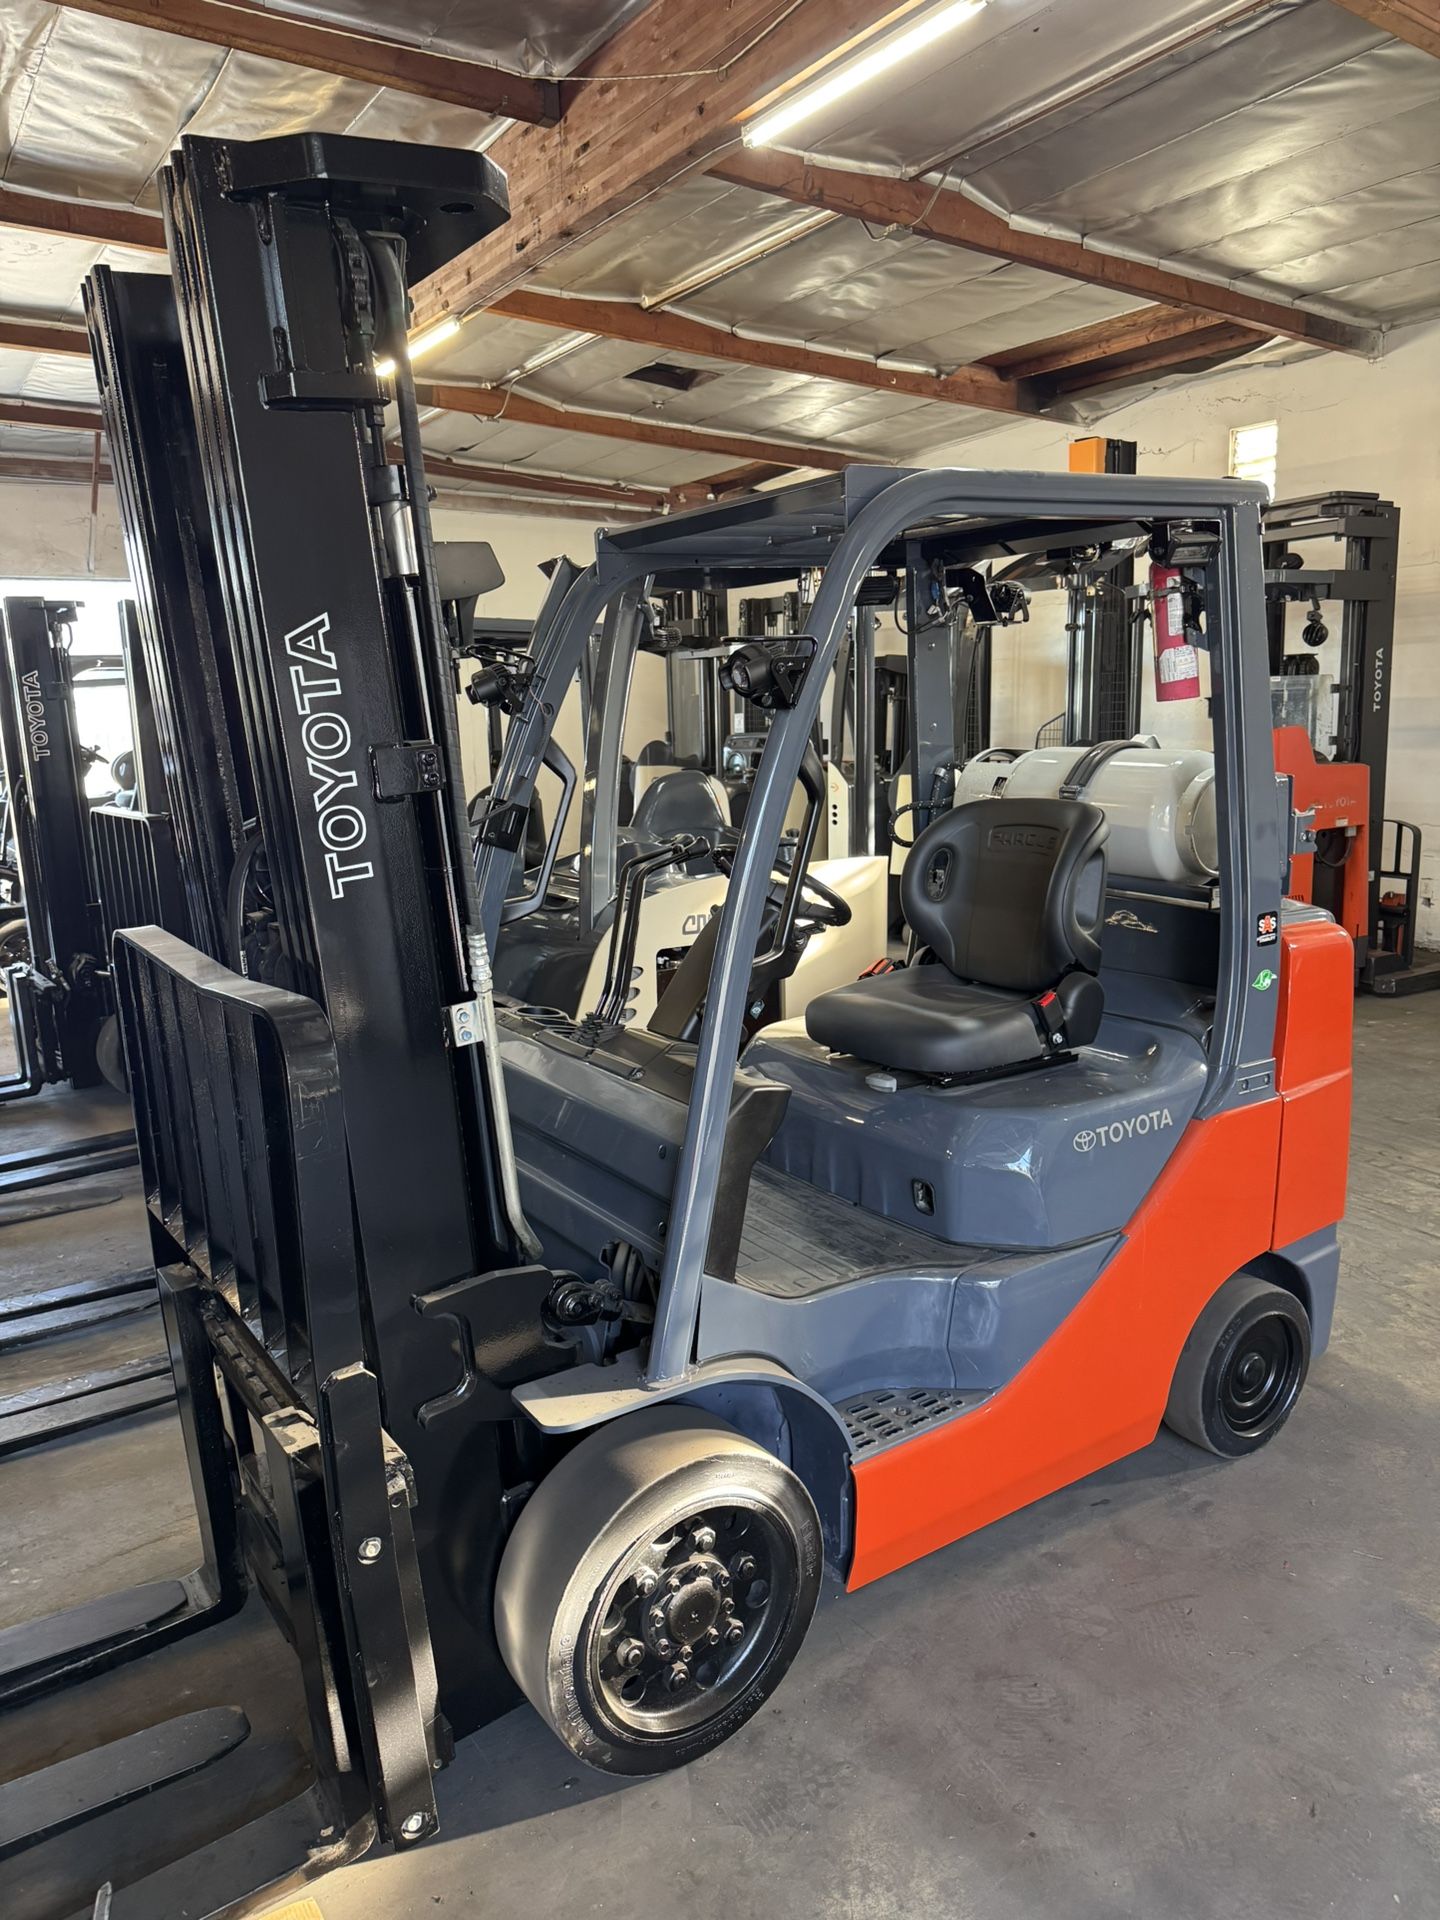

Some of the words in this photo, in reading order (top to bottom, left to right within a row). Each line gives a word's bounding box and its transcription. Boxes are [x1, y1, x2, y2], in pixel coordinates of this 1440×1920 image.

[22, 670, 51, 762] TOYOTA
[1373, 647, 1384, 712] TOYOTA
[284, 612, 374, 899] TOYOTA
[1096, 1108, 1173, 1147] TOYOTA
